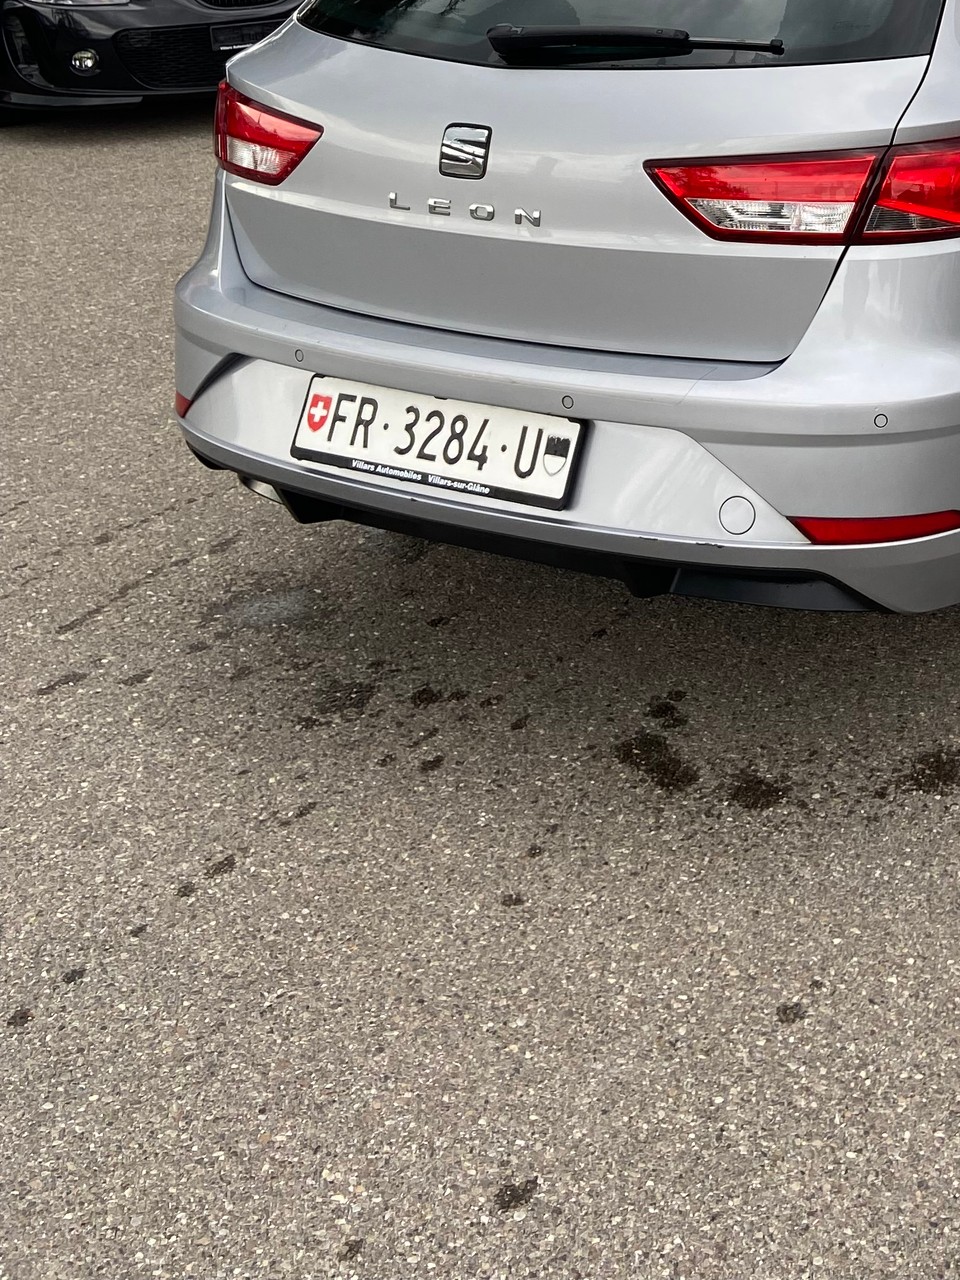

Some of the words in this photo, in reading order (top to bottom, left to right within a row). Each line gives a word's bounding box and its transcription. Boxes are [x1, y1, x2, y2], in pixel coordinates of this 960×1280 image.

[388, 192, 541, 227] LEON
[352, 460, 375, 471] Villars
[376, 465, 422, 480] Automobiles
[428, 474, 490, 494] Villars-sur-Glâne
